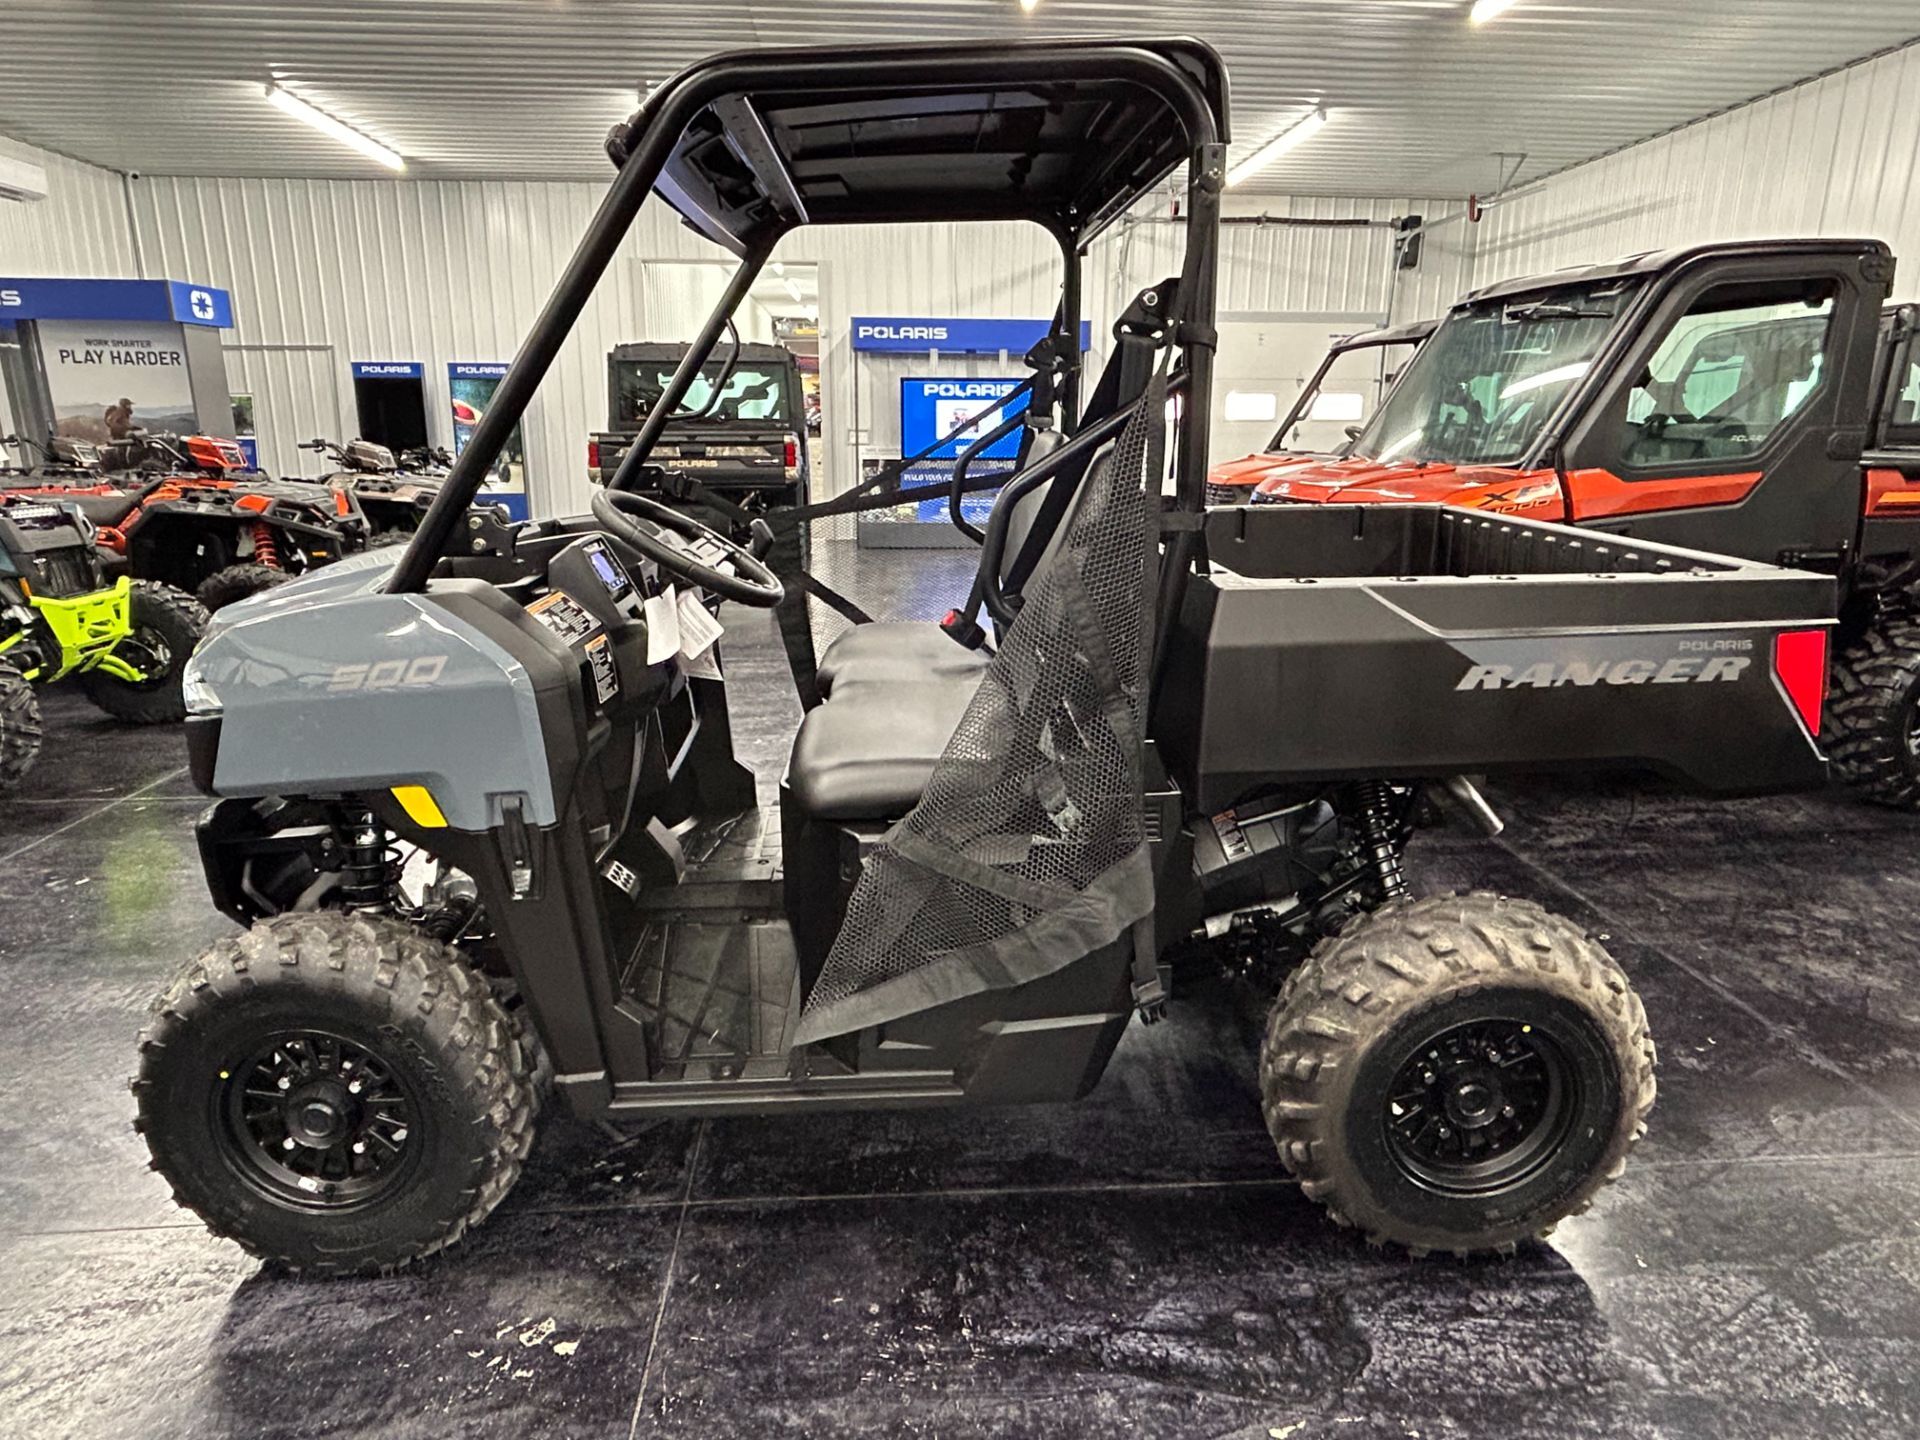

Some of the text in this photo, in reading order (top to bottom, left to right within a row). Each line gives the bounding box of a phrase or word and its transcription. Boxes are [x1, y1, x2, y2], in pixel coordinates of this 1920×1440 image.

[858, 326, 948, 340] POLARIS
[84, 338, 152, 348] WORK SMARTER
[59, 349, 181, 366] PLAY HARDER
[360, 365, 412, 374] POLARIS
[667, 460, 719, 468] POLARIS
[1678, 638, 1754, 652] POLARIS
[326, 655, 449, 692] 500
[1453, 656, 1752, 692] RANGER
